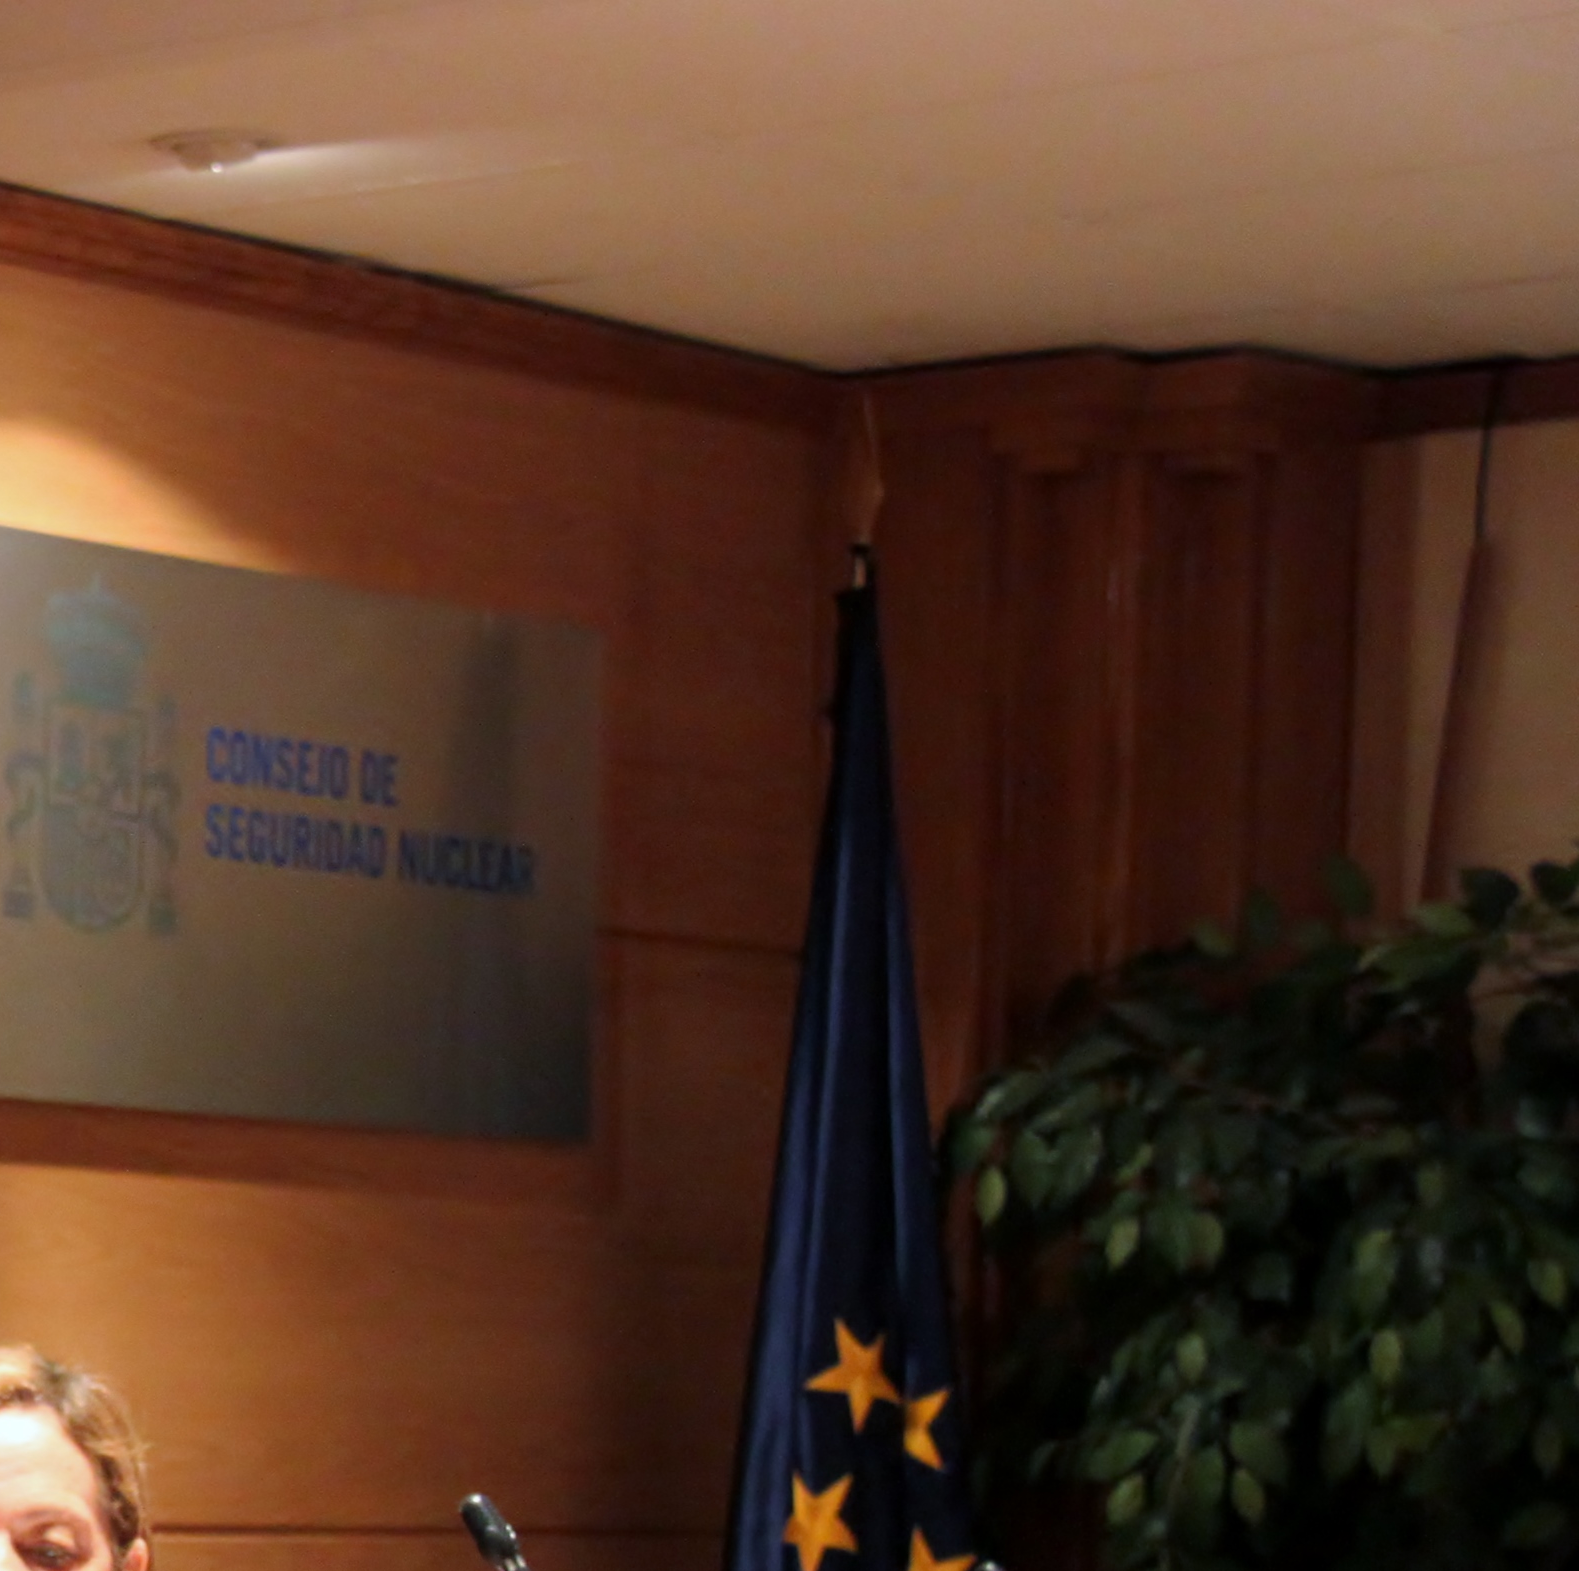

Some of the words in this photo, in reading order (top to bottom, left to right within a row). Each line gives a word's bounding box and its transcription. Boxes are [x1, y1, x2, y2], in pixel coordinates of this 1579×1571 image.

[205, 726, 349, 799] CONSEJO
[360, 750, 399, 808] DE
[205, 802, 388, 879] SEGURIDAD
[397, 828, 538, 895] NUCLEAR
